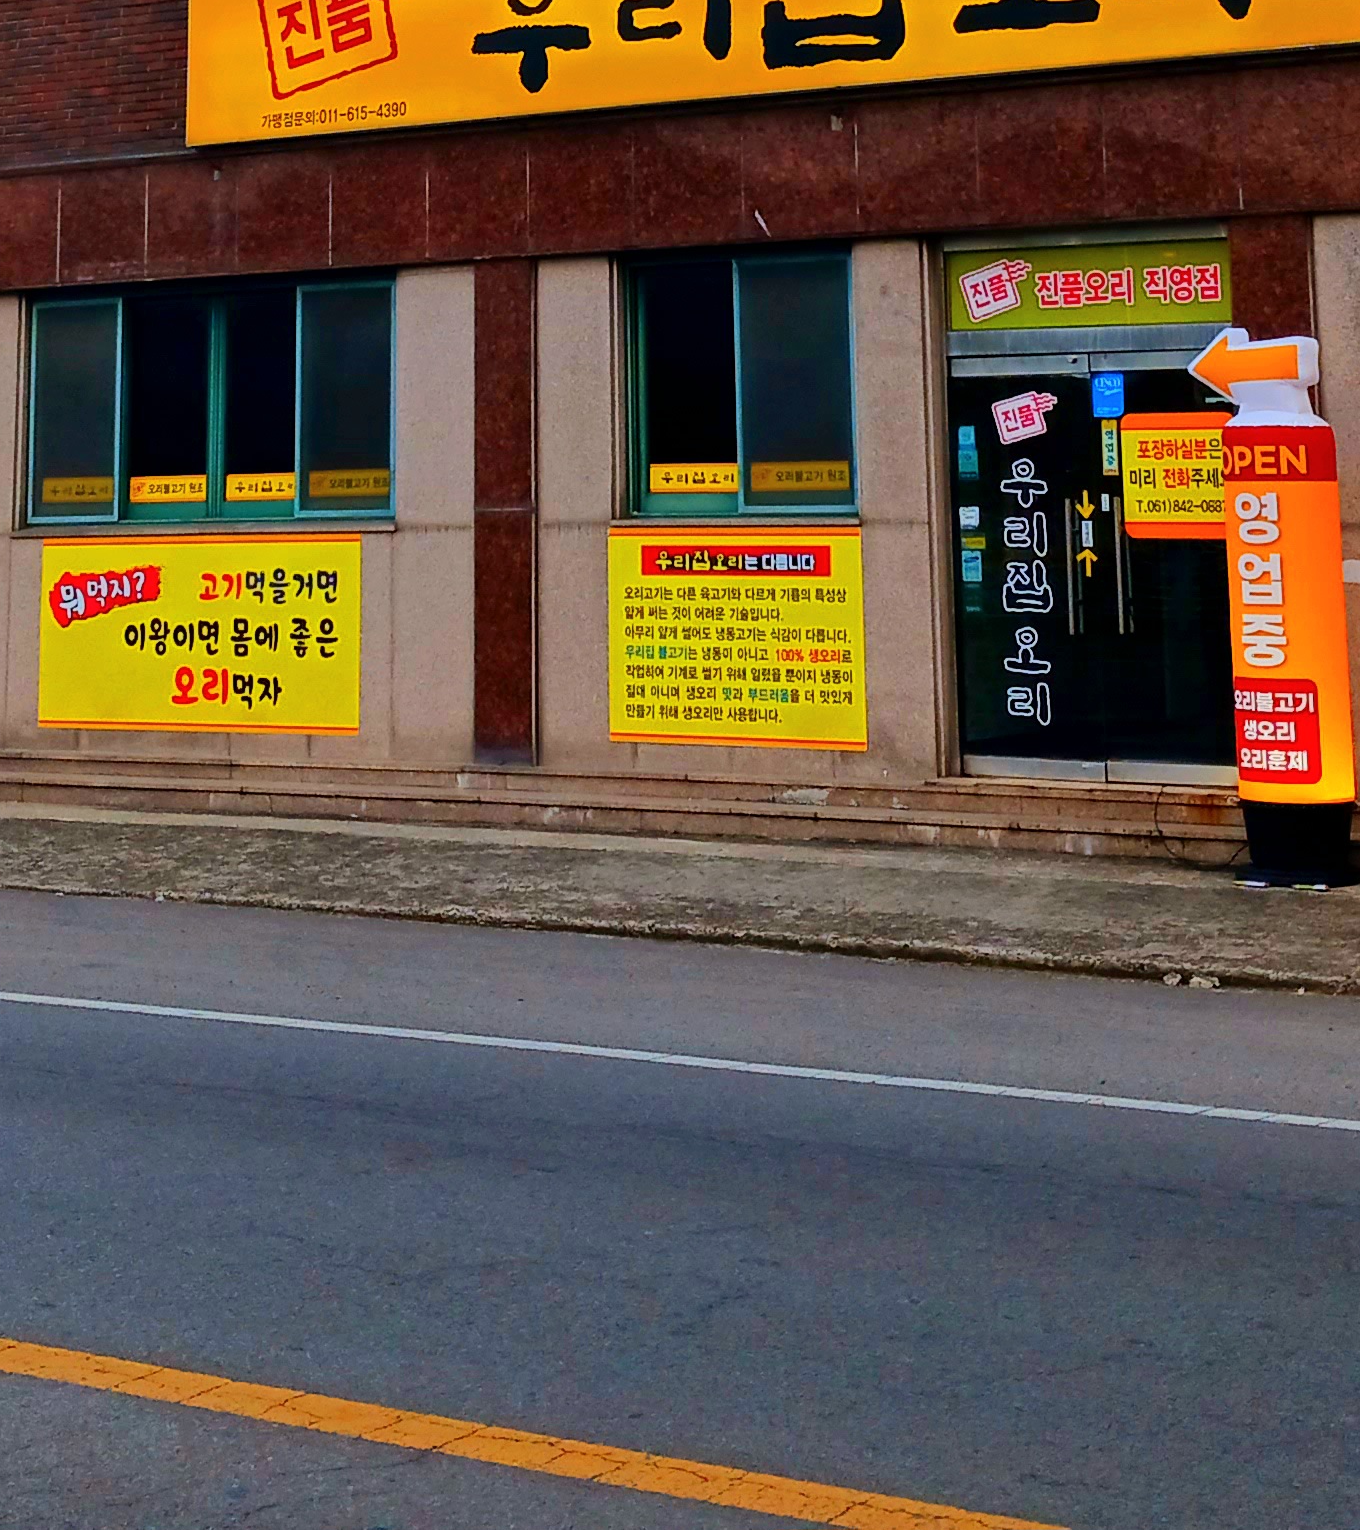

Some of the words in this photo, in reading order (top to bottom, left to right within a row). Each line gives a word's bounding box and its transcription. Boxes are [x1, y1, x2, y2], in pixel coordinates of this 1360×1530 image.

[969, 274, 1008, 308] 진품
[1036, 269, 1133, 307] 진품오리
[1144, 264, 1220, 302] 직영점
[1000, 407, 1036, 430] 진품
[1137, 438, 1222, 460] 포장하실분은
[1223, 445, 1307, 475] OPEN
[1130, 468, 1156, 489] 미리
[1163, 468, 1224, 489] 전화주세
[199, 568, 338, 604] 고기먹을거면
[1235, 492, 1287, 667] 영업중
[59, 584, 85, 618] 뭐
[86, 571, 145, 607] 먹지?
[624, 587, 673, 600] 오리고기는
[745, 587, 776, 602] 다르게
[125, 618, 219, 656] 이왕이면
[230, 618, 278, 657] 몸에
[290, 618, 338, 658] 좋은
[625, 627, 654, 639] 아무리
[737, 648, 769, 661] 아니고
[171, 666, 282, 710] 오리먹자
[1234, 690, 1314, 713] 오리불고기
[1244, 720, 1296, 742] 생오리
[1241, 748, 1308, 771] 오리훈제
